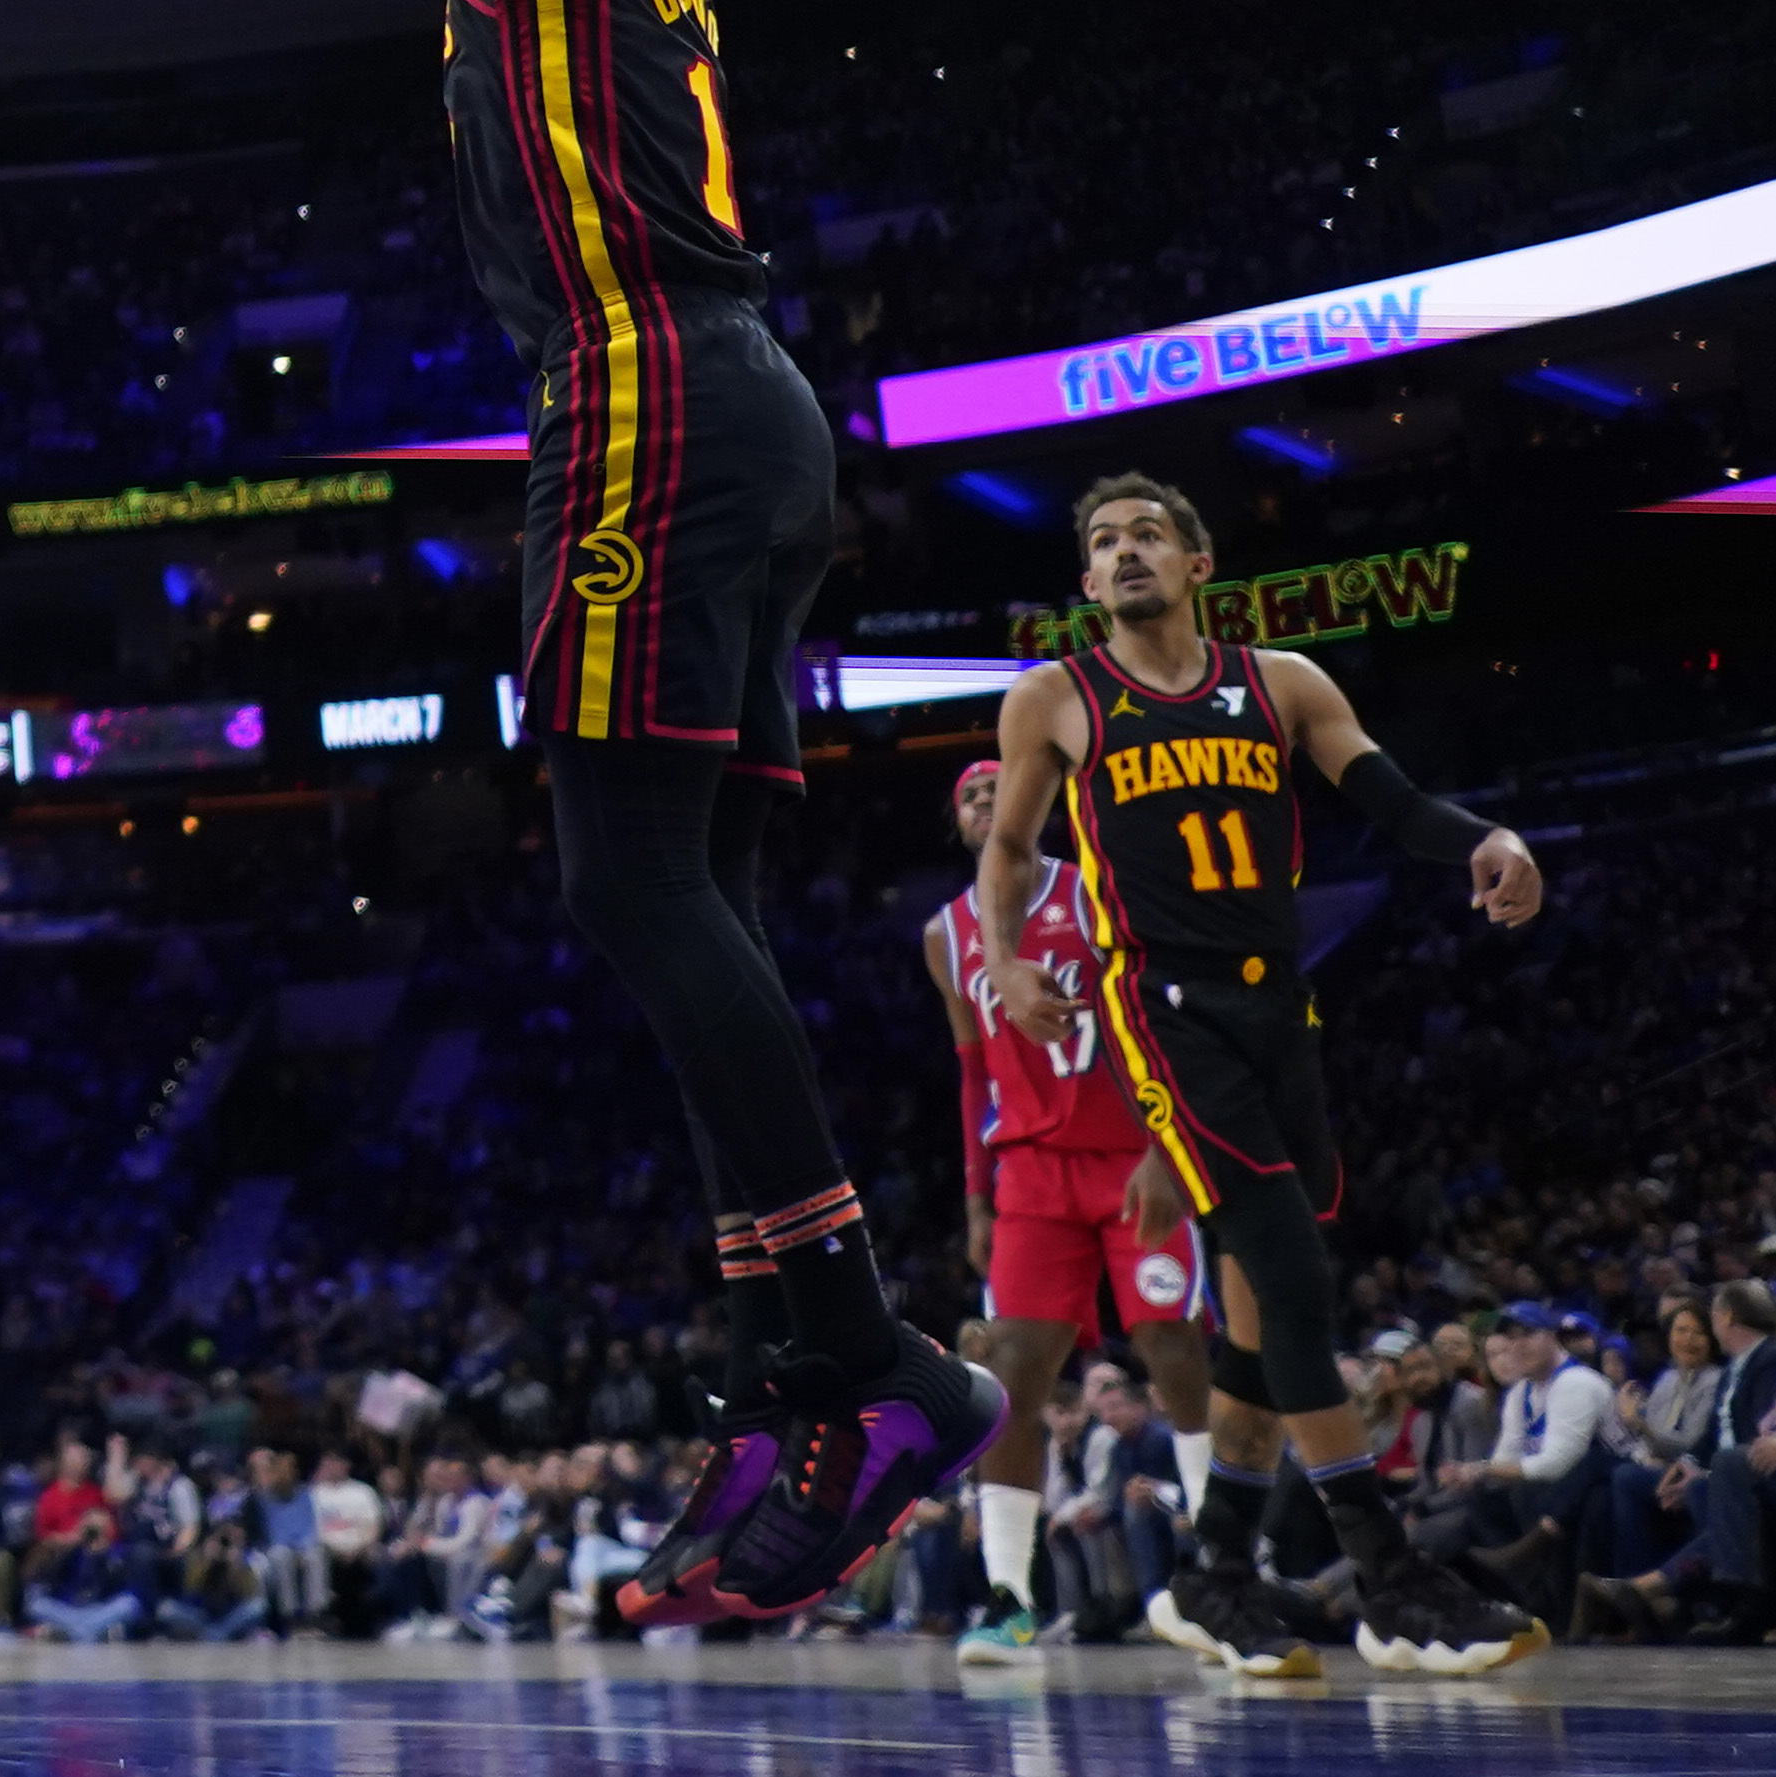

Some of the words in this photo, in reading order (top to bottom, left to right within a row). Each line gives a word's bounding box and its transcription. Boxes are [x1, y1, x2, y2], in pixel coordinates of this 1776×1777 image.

[1058, 338, 1204, 418] five
[1213, 284, 1436, 383] BELOW
[320, 697, 423, 750] MARCH
[423, 694, 444, 742] 7
[1103, 736, 1280, 805] HAWKS
[1177, 809, 1260, 892] 11
